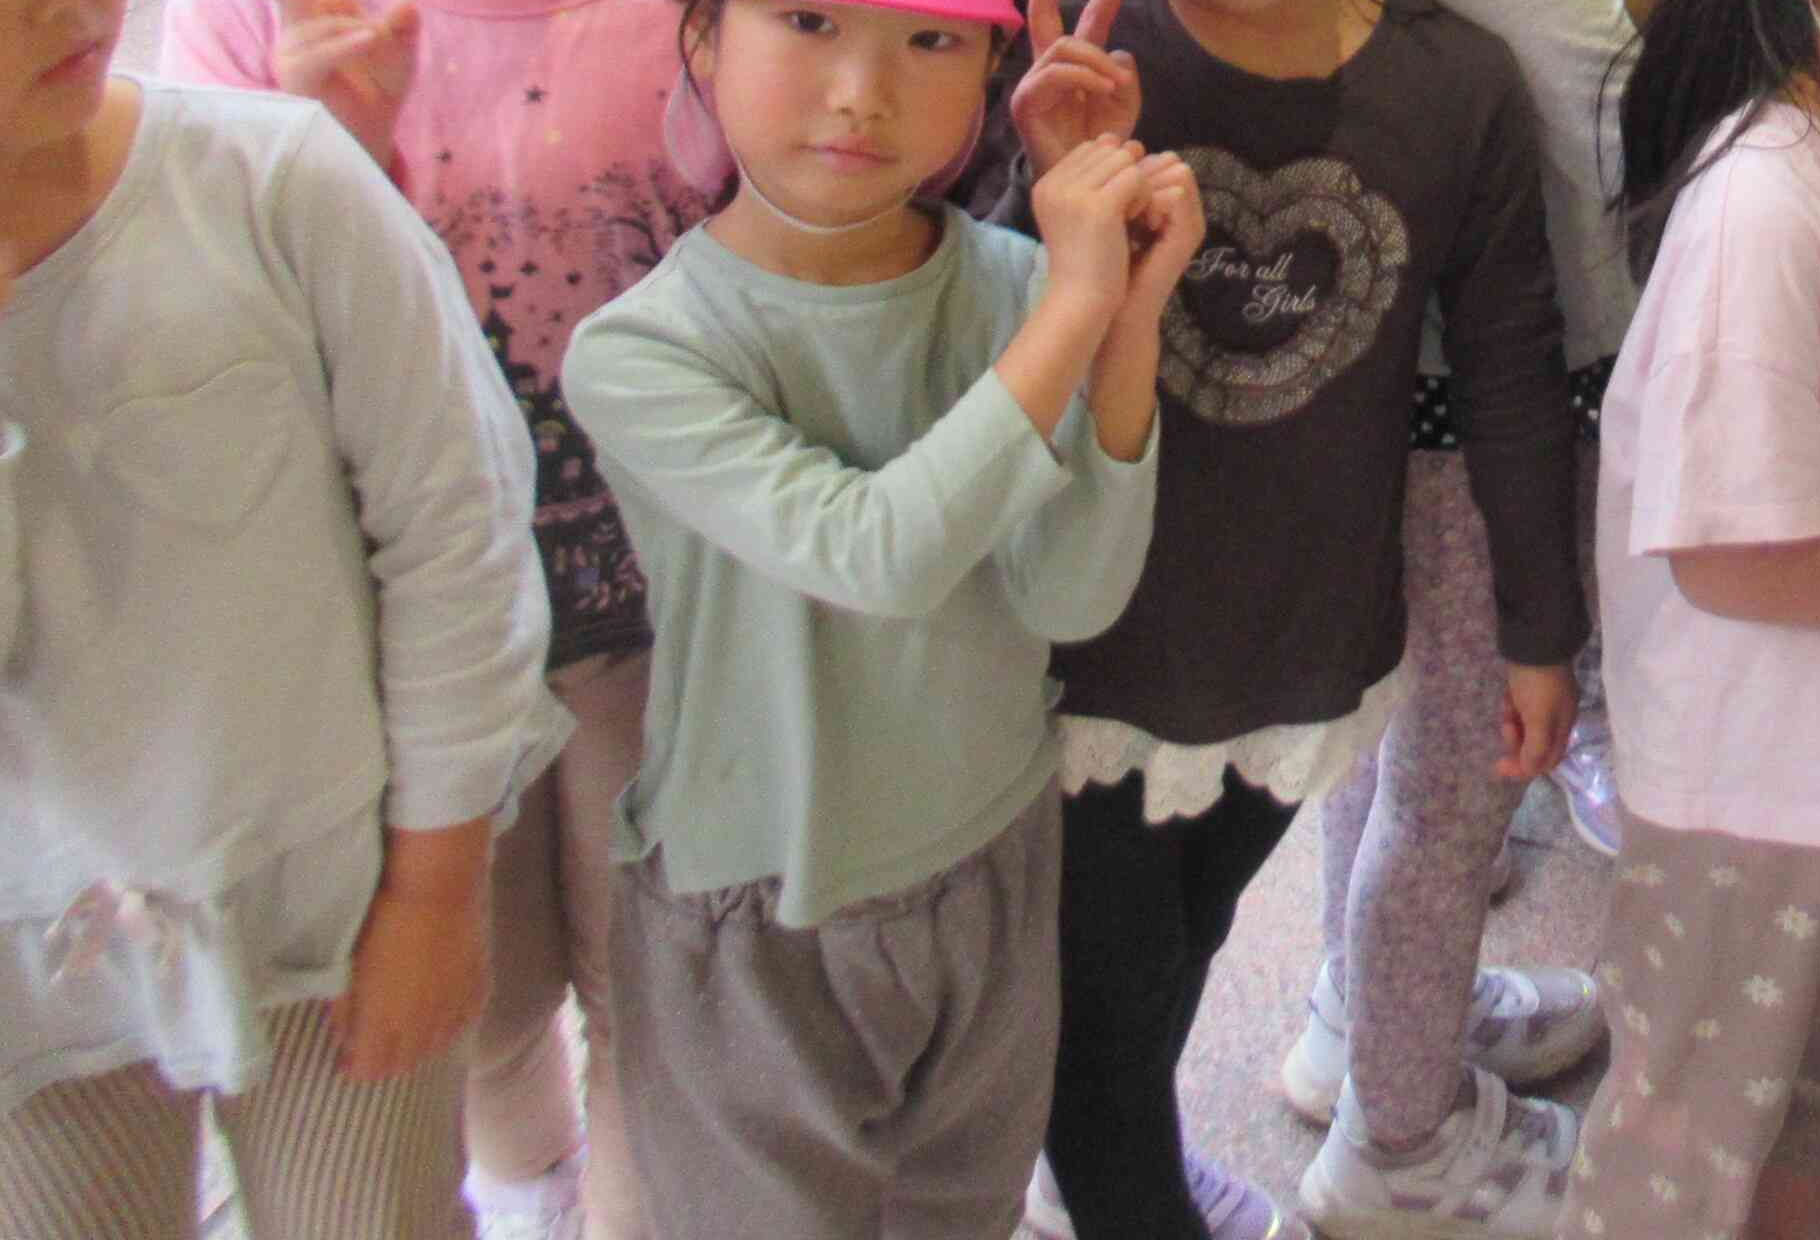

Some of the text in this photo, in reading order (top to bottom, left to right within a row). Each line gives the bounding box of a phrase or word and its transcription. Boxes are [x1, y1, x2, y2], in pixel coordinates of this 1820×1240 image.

[1186, 246, 1294, 281] For all
[1240, 284, 1317, 323] Girls
